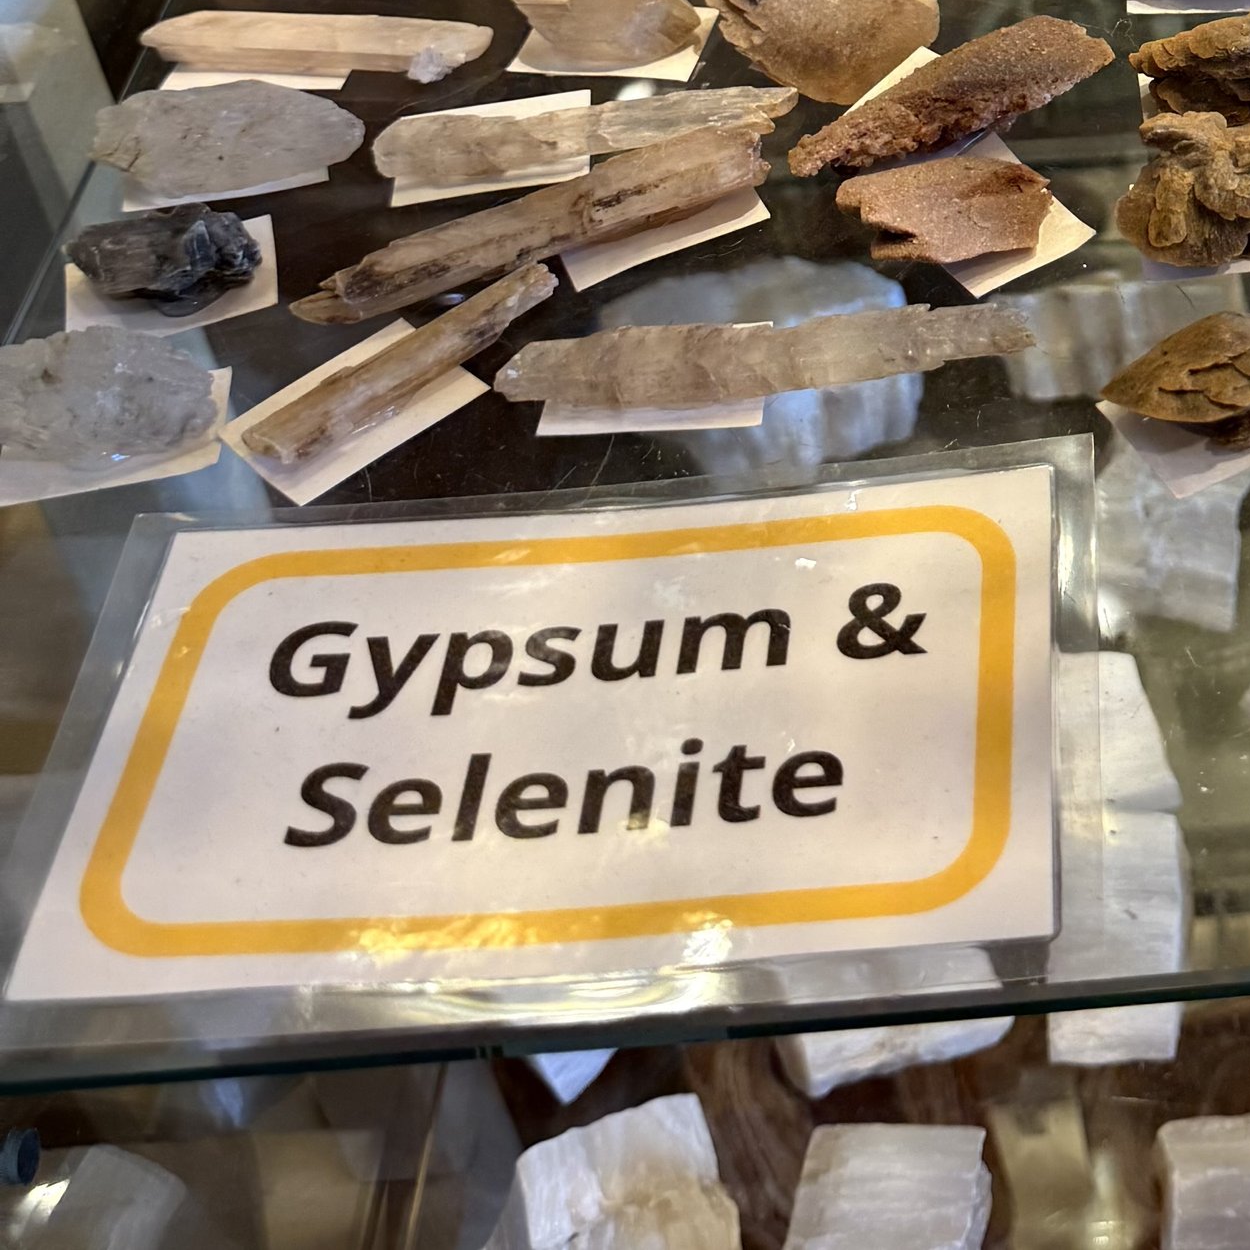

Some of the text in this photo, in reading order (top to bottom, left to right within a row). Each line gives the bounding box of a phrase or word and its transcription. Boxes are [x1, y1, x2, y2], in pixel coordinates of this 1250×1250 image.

[269, 583, 927, 720] Gypsum &
[284, 738, 843, 848] Selenite
